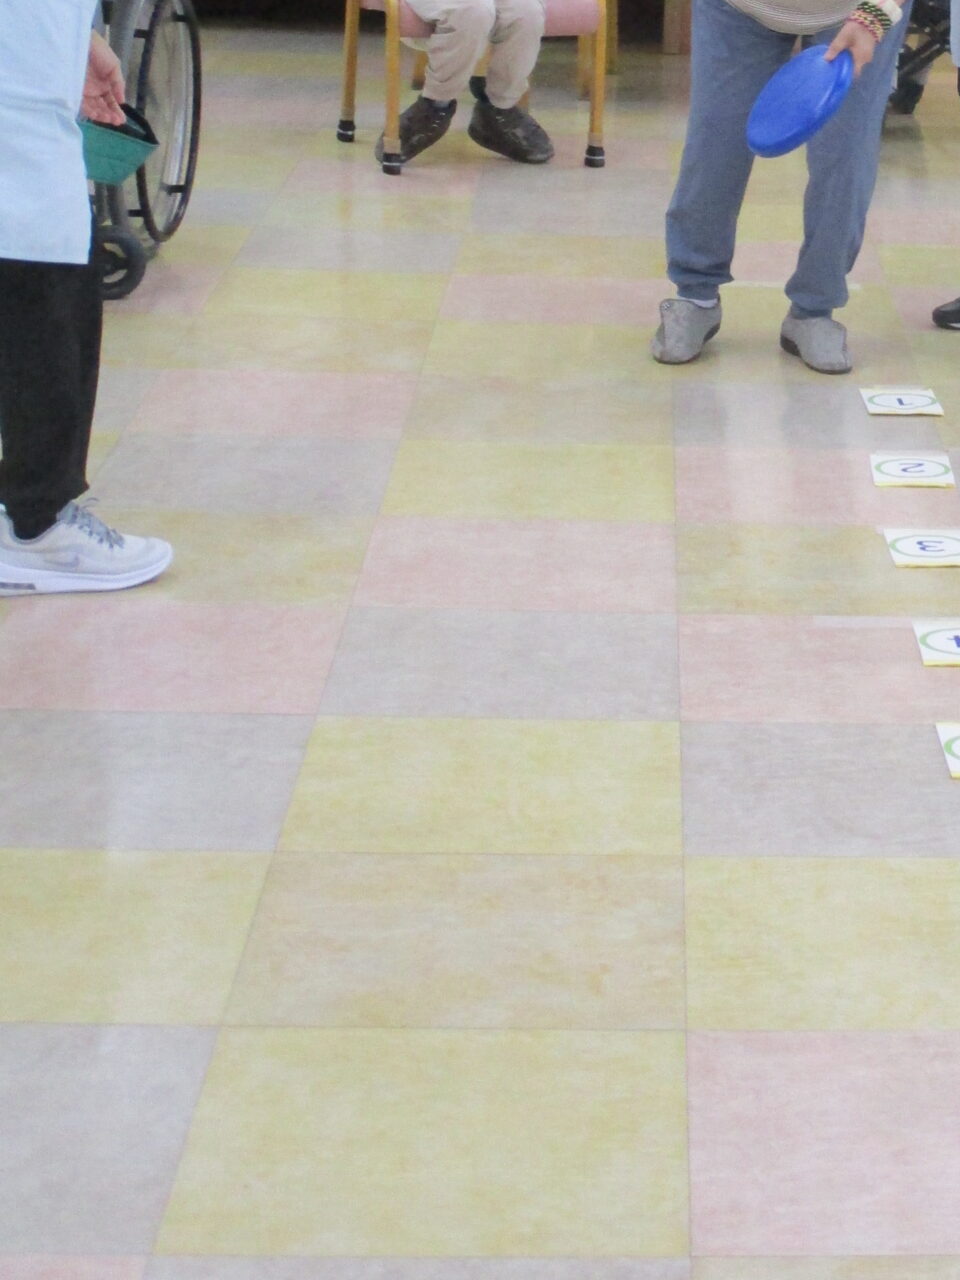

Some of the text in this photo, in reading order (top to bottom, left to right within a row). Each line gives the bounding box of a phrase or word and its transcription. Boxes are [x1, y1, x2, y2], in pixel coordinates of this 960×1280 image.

[896, 397, 914, 407] 1
[899, 462, 926, 474] 2
[915, 539, 946, 554] 3
